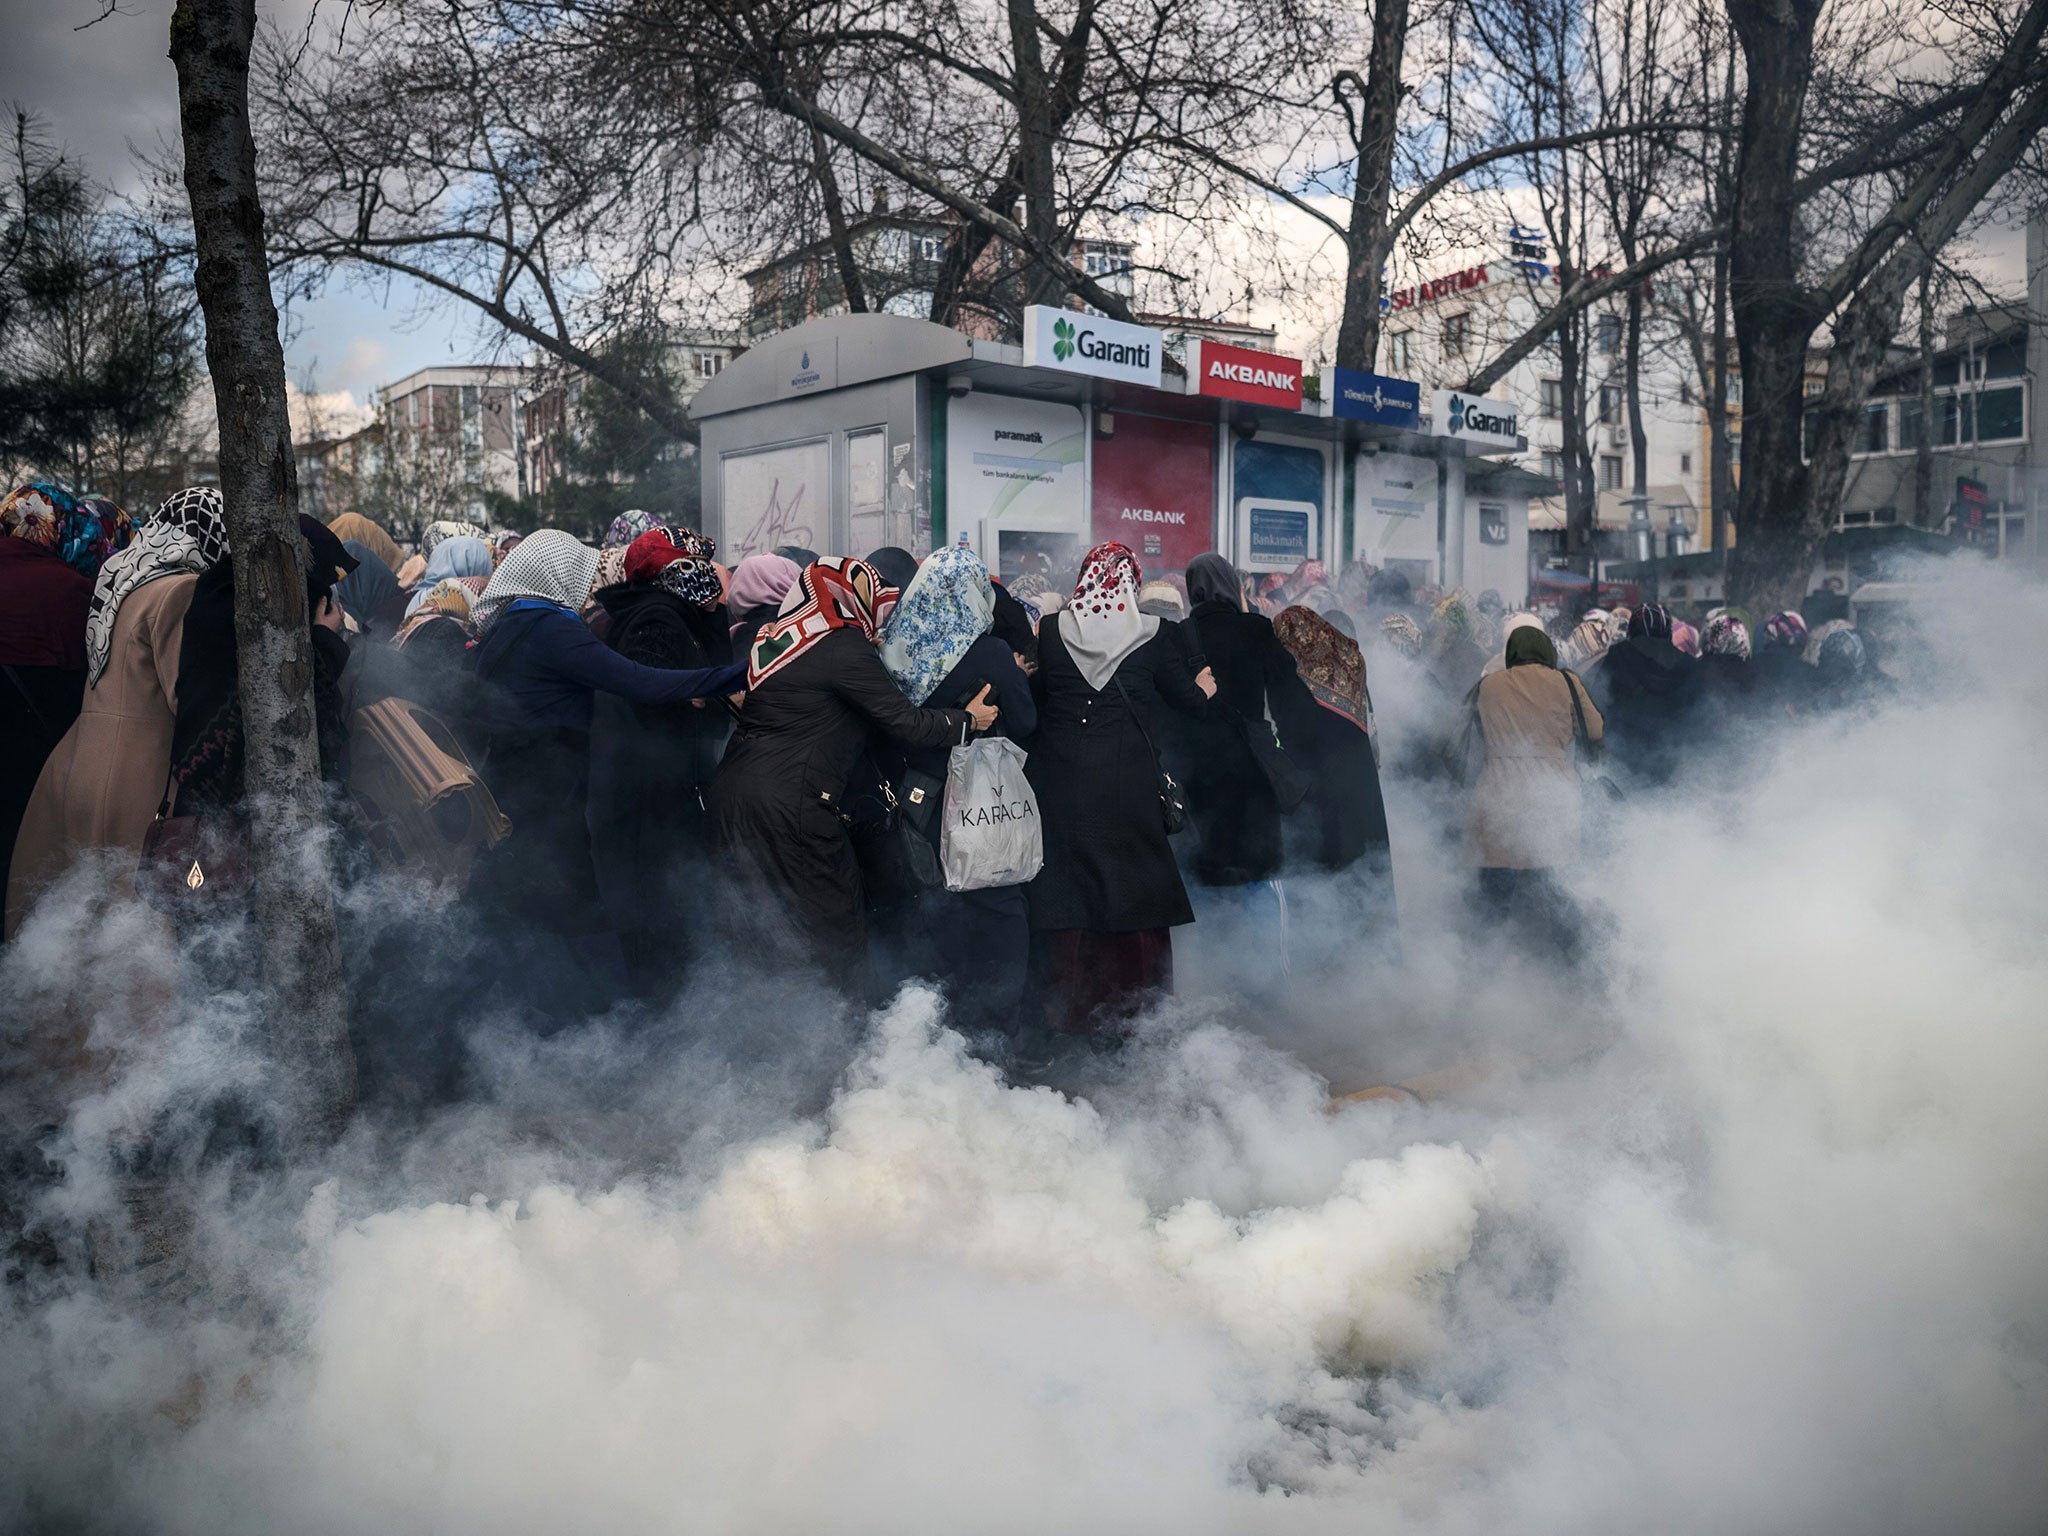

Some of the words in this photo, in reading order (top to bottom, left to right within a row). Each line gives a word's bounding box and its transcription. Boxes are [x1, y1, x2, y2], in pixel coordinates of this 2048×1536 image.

[1392, 287, 1414, 310] SU
[1077, 330, 1150, 368] Garanti
[1209, 361, 1296, 391] AKBANK
[1465, 404, 1517, 437] Garanti
[994, 430, 1043, 443] paramatik
[1121, 507, 1186, 525] AKBANK
[1253, 532, 1304, 547] Bankamatik
[961, 800, 1033, 827] KARACA
